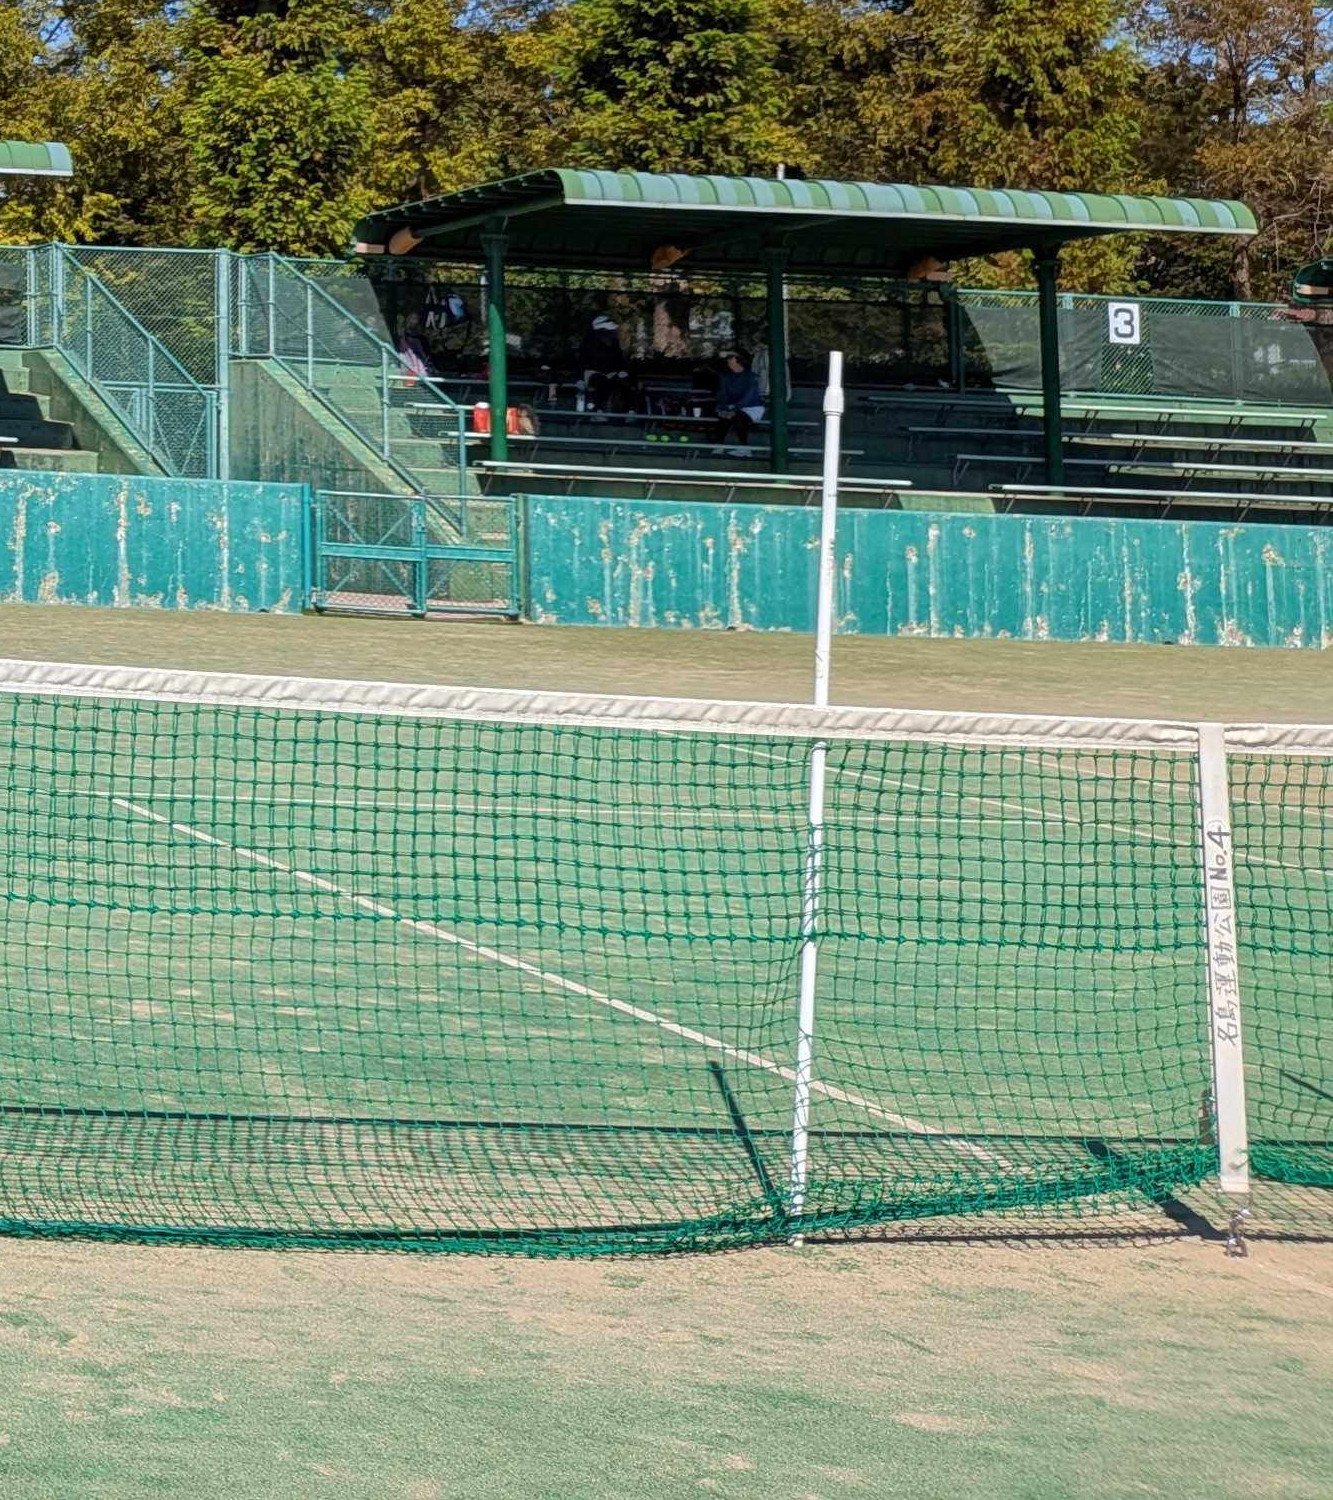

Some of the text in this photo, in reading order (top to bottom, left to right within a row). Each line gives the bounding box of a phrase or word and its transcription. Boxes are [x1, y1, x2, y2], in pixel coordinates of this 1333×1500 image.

[1114, 308, 1135, 338] 3
[1207, 824, 1238, 1046] 名島運動公園 No.4
